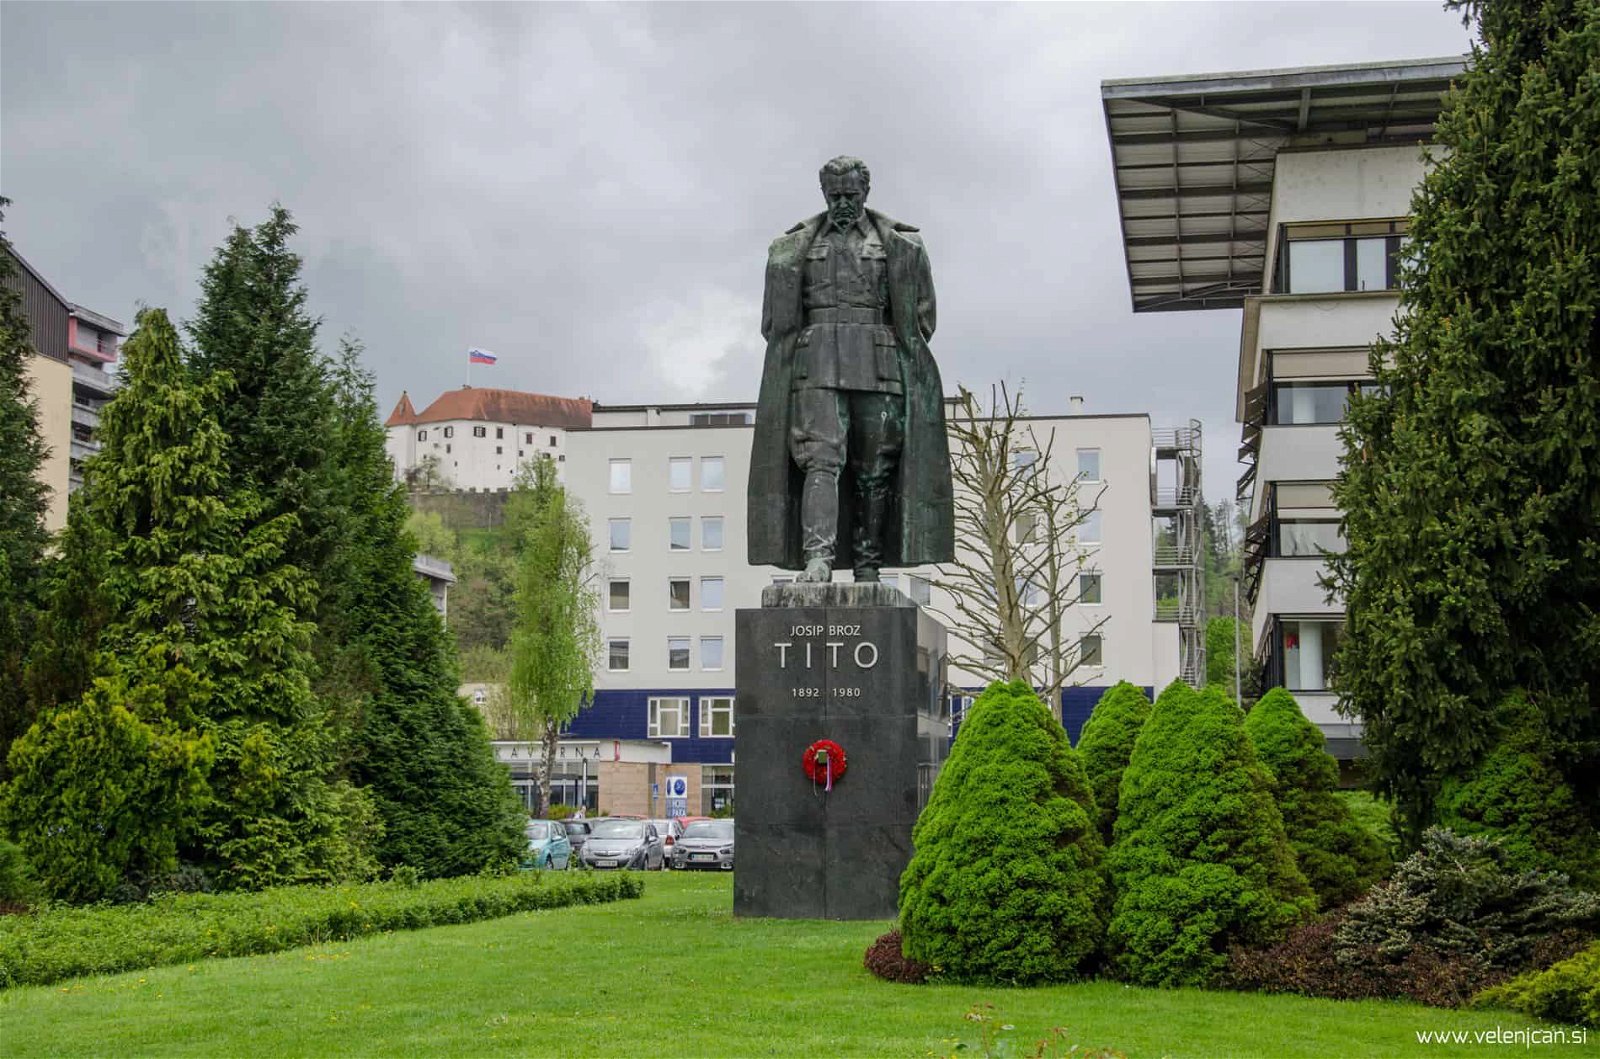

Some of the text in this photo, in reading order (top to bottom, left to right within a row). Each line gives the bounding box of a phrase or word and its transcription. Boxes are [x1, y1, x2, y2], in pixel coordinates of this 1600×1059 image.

[790, 625, 861, 637] JOSIP BROZ
[773, 642, 878, 668] TITO
[792, 688, 861, 697] 1892 1980
[495, 746, 601, 758] KAVRNA
